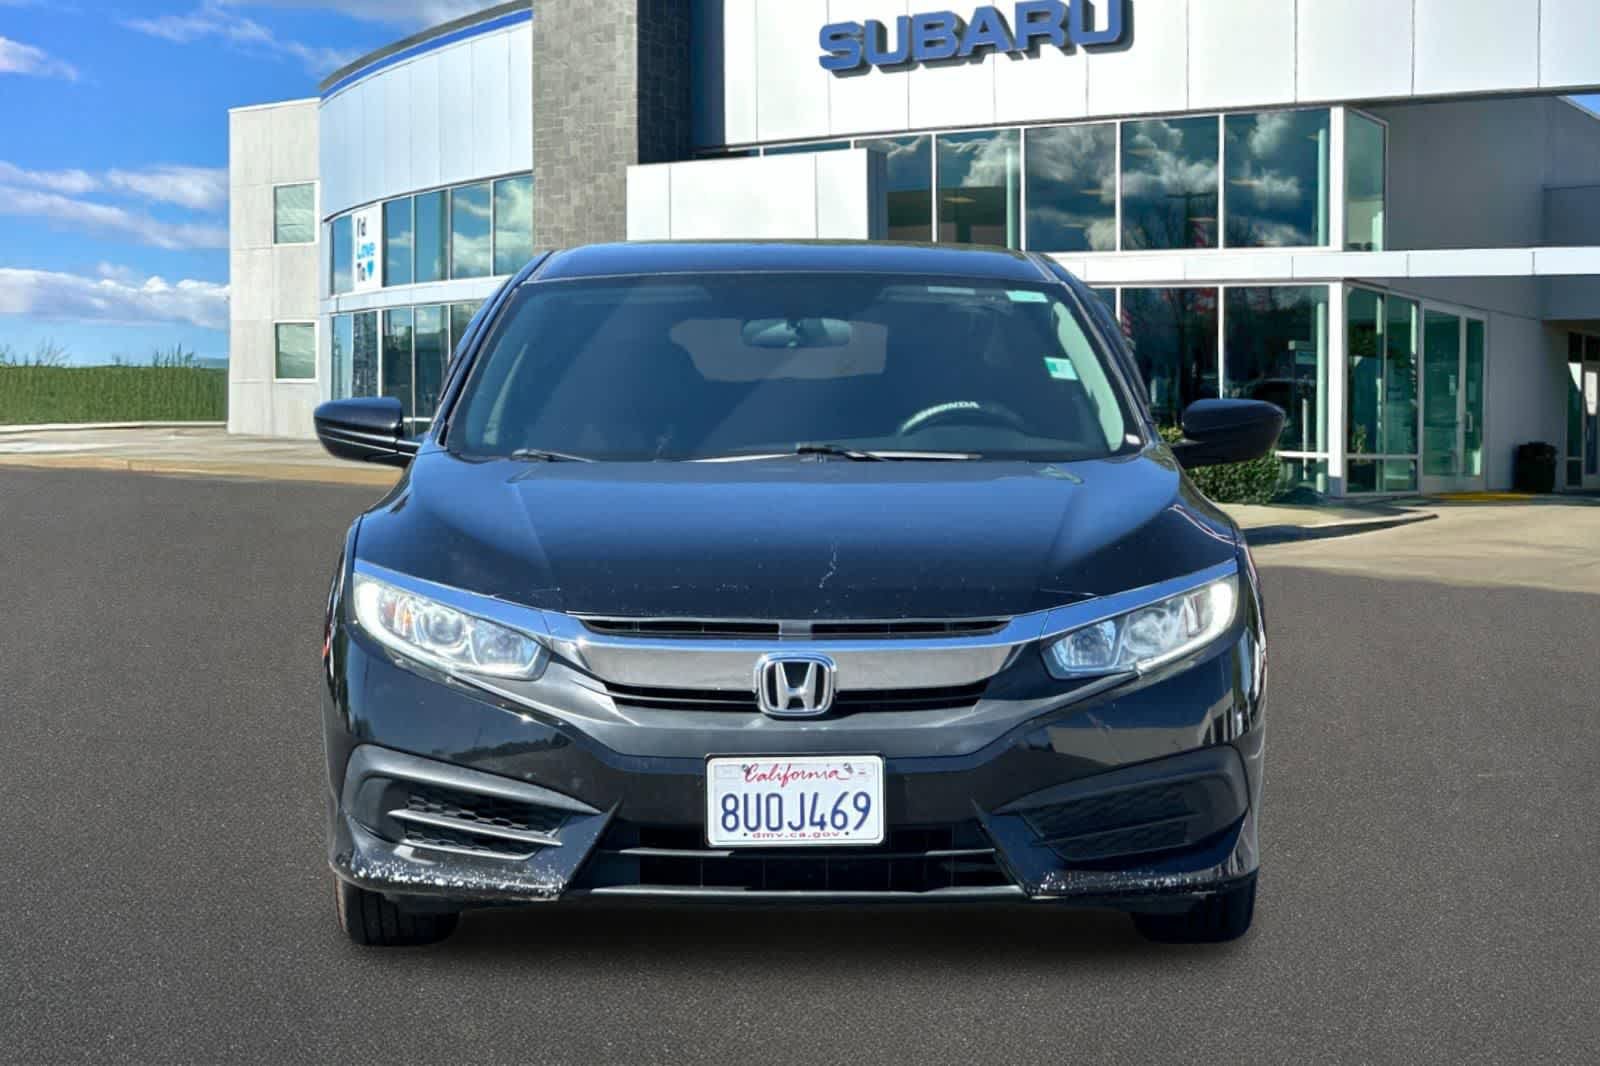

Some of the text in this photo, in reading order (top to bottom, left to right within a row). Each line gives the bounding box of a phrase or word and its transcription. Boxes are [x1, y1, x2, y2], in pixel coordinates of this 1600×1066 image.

[819, 0, 1126, 73] SUBARU
[744, 763, 849, 788] California
[752, 830, 841, 840] dmv.ca.gov
